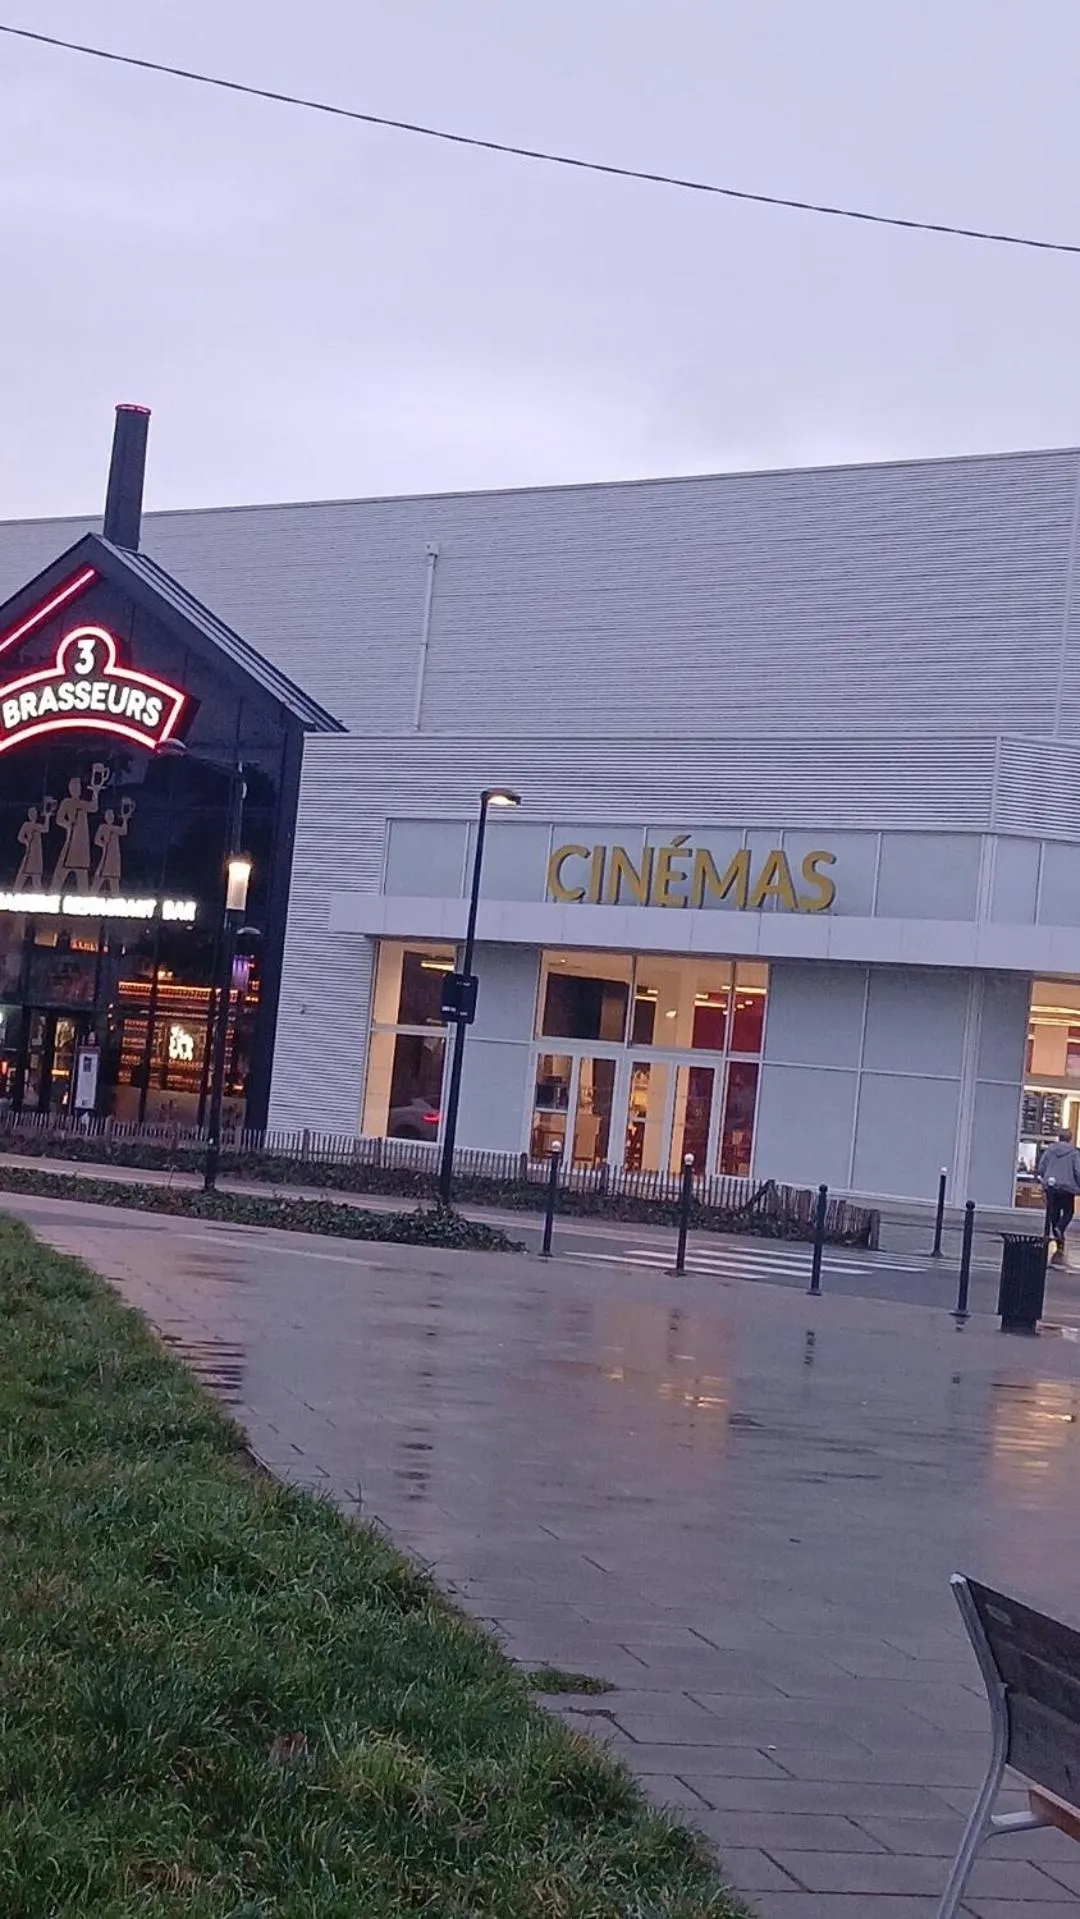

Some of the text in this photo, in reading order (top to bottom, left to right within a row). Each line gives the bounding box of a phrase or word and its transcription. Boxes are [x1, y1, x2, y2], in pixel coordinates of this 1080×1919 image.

[74, 639, 96, 675] 3
[2, 680, 163, 729] BRASSEURS
[547, 834, 838, 912] CINÉMAS
